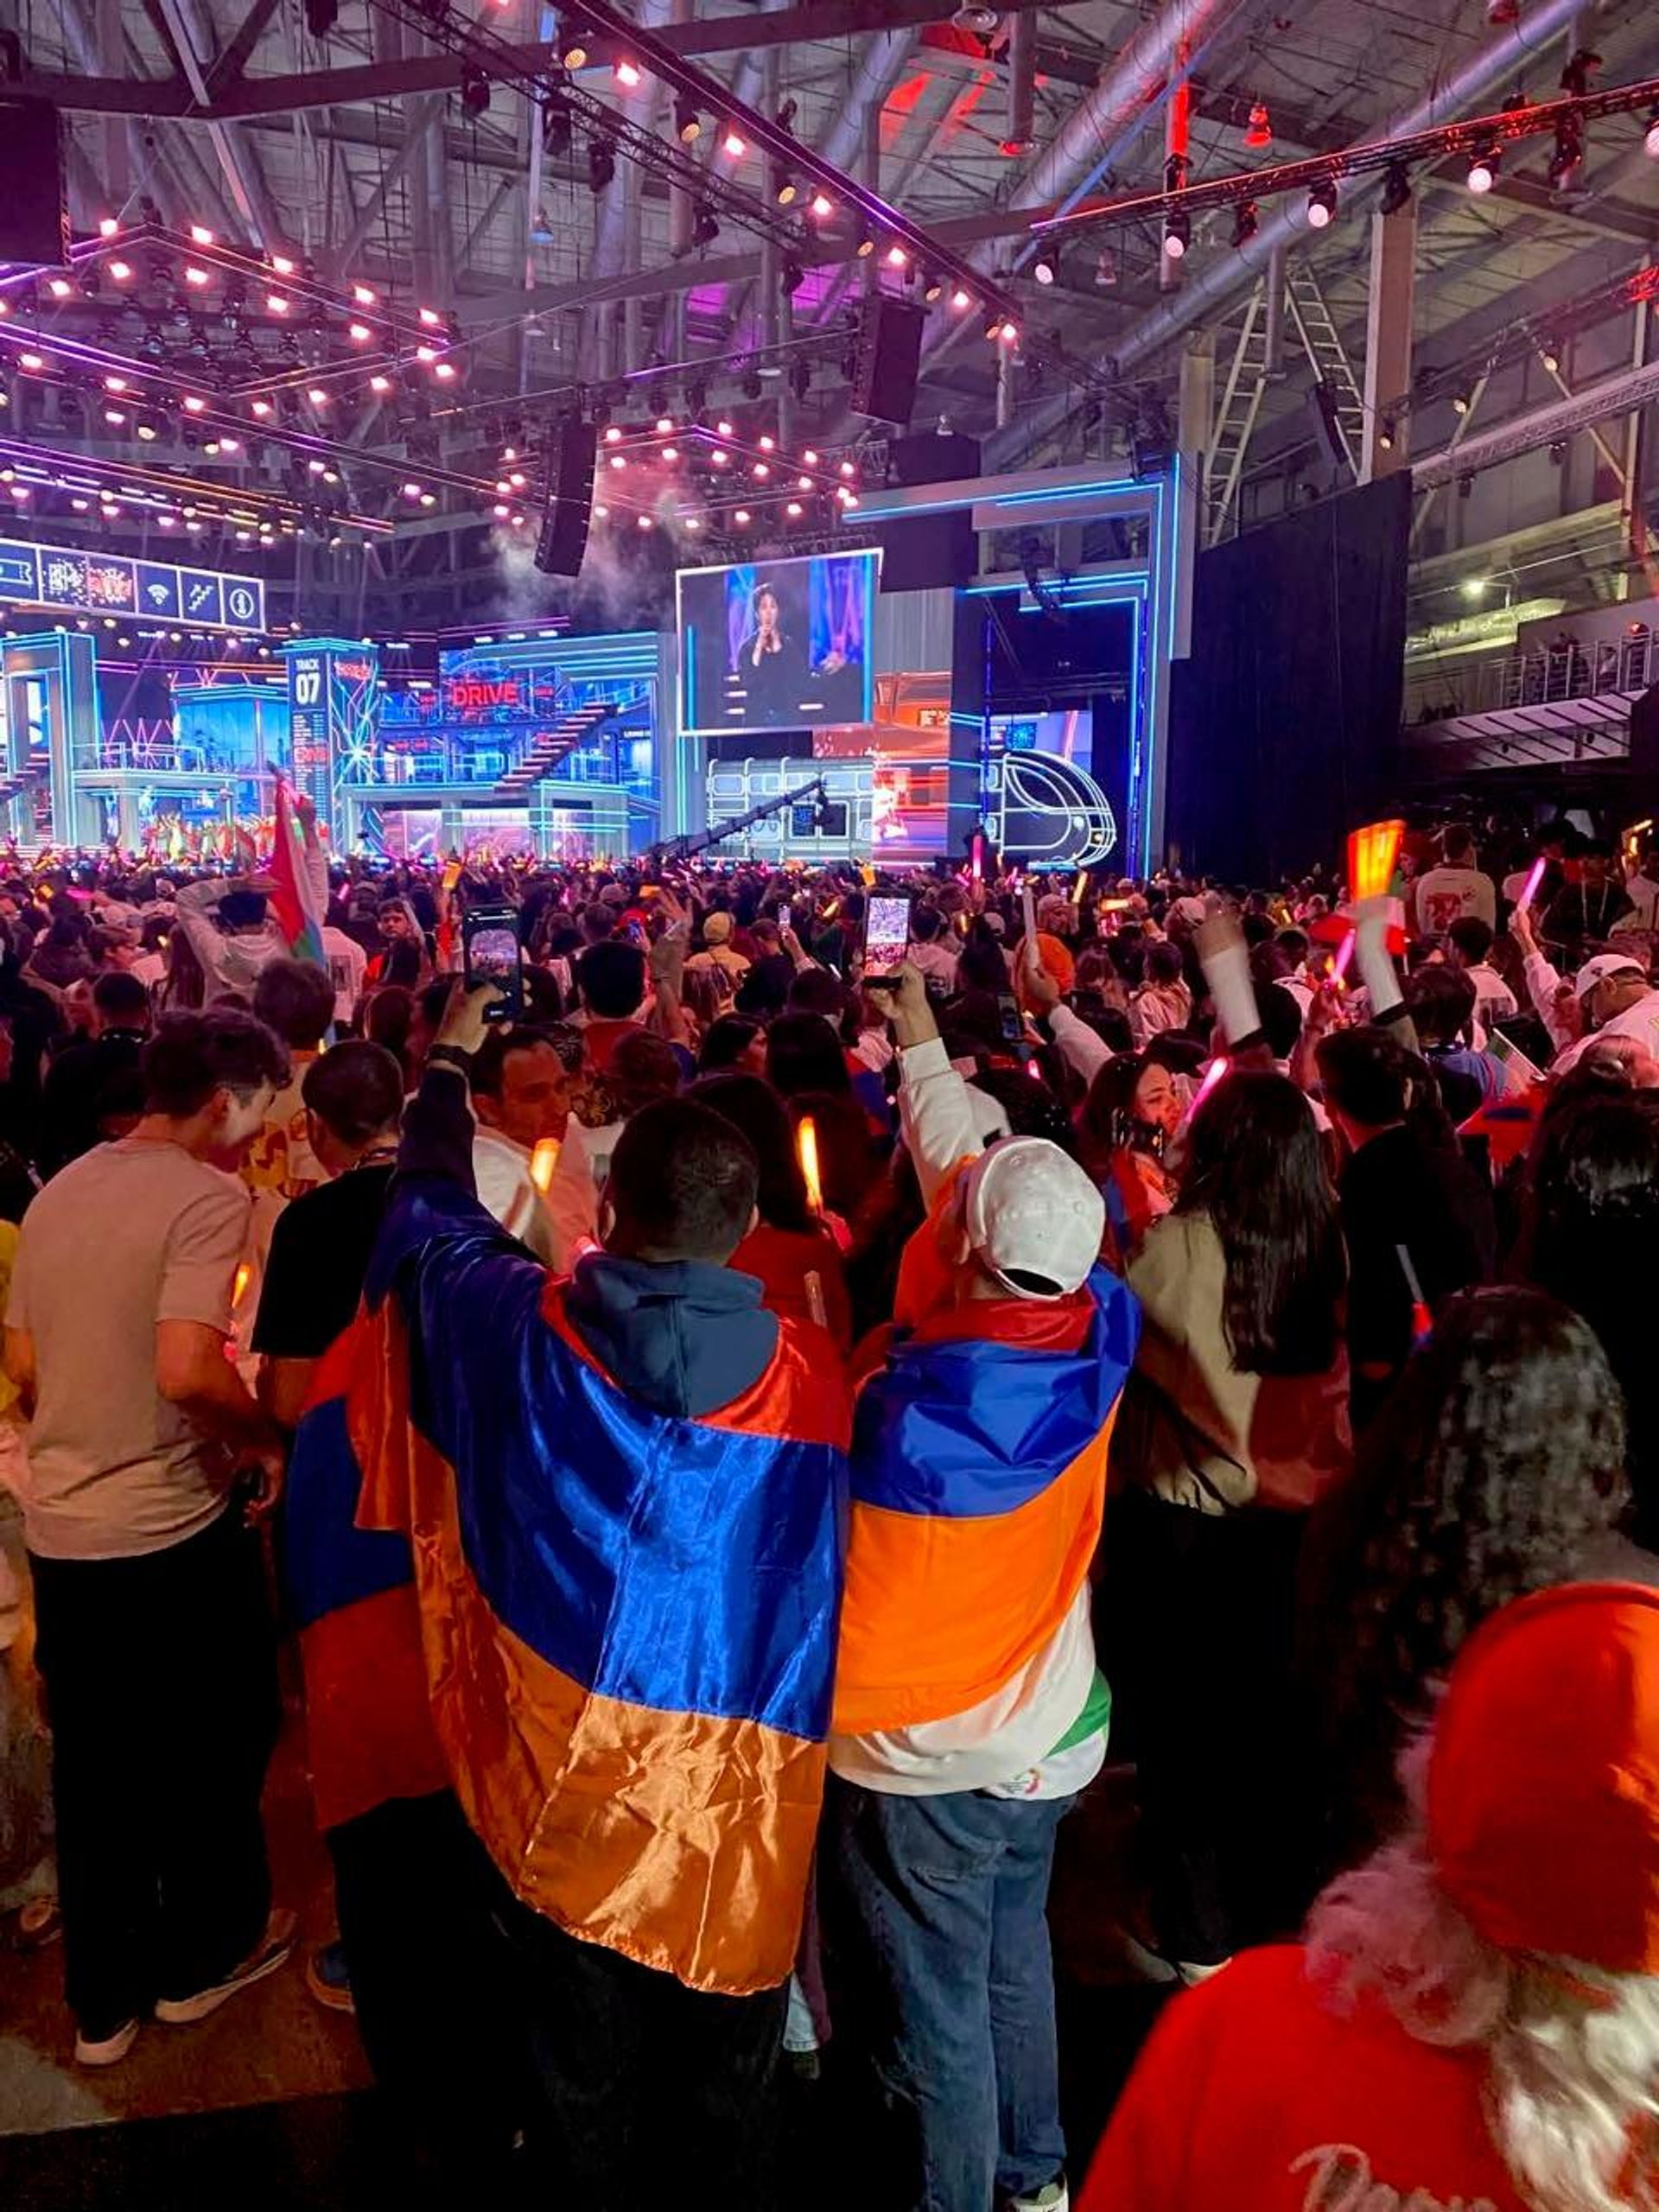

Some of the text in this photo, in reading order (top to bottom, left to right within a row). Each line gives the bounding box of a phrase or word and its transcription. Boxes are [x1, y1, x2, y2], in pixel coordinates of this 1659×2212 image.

[296, 658, 320, 671] TRACK
[296, 672, 321, 705] 07
[452, 682, 518, 707] DRIVE
